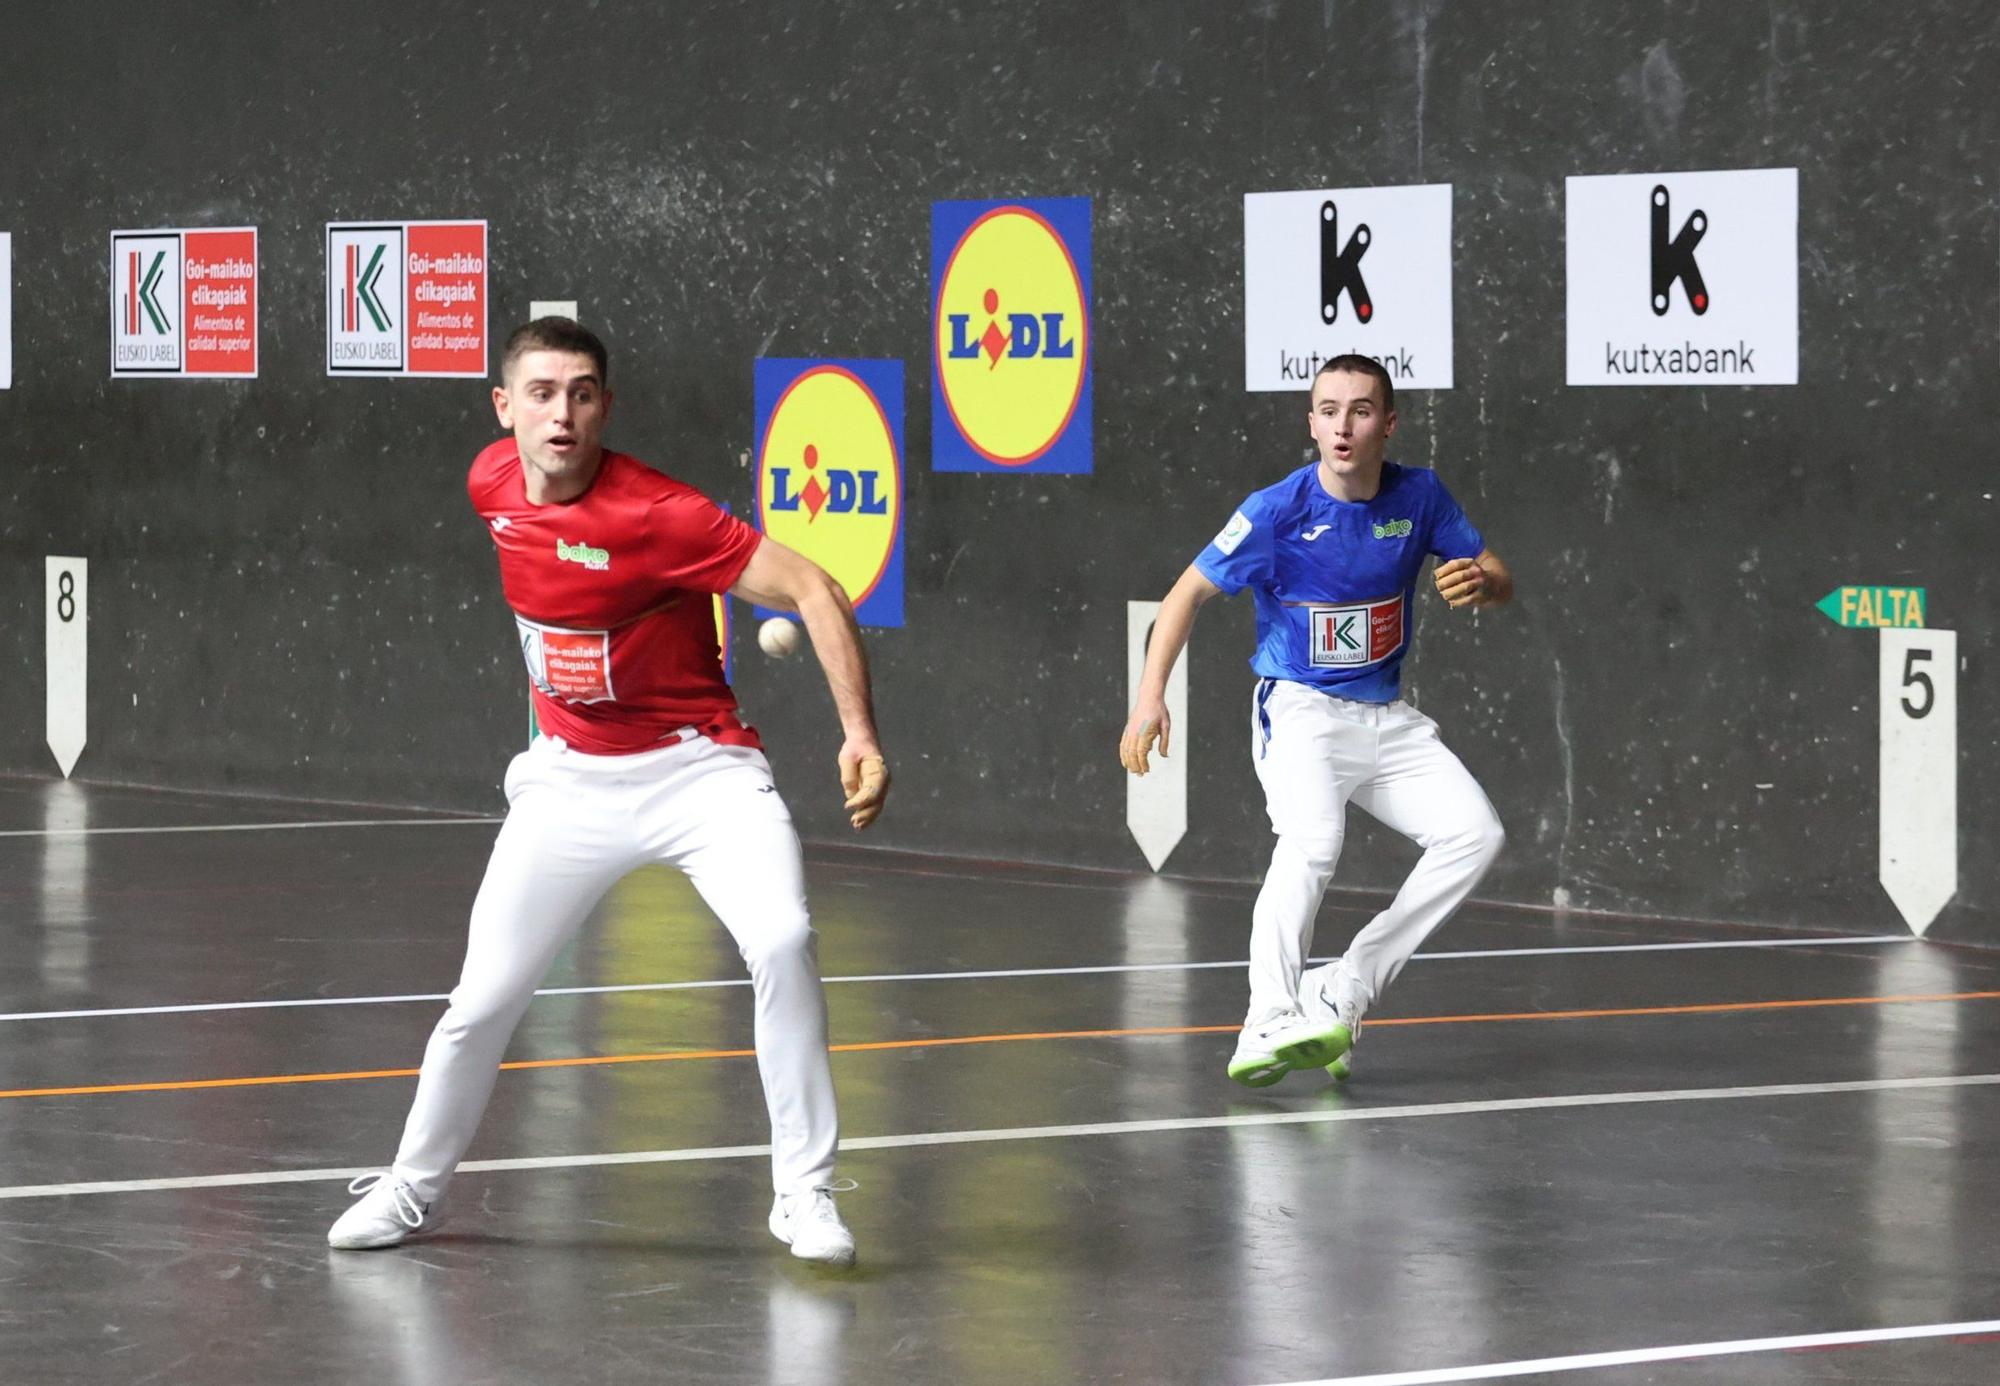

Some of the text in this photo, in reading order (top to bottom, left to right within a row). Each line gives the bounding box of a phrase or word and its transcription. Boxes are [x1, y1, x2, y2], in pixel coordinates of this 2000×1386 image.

[186, 257, 253, 280] Goi-mailako
[409, 252, 483, 275] Goi-mailako
[191, 284, 247, 311] elikagaiak
[415, 280, 476, 307] elikagaiak
[193, 314, 245, 331] Alimentos de
[416, 311, 474, 329] Alimentos de
[118, 344, 176, 362] EUSKO LABEL
[188, 335, 251, 354] calidad superior
[334, 341, 398, 360] EUSKO LABEL
[411, 332, 480, 352] calidad superior
[1606, 340, 1755, 374] kutxabank
[57, 570, 75, 623] 8
[1841, 588, 1925, 628] FALTA
[1343, 651, 1365, 661] LABEL
[1900, 648, 1934, 719] 5
